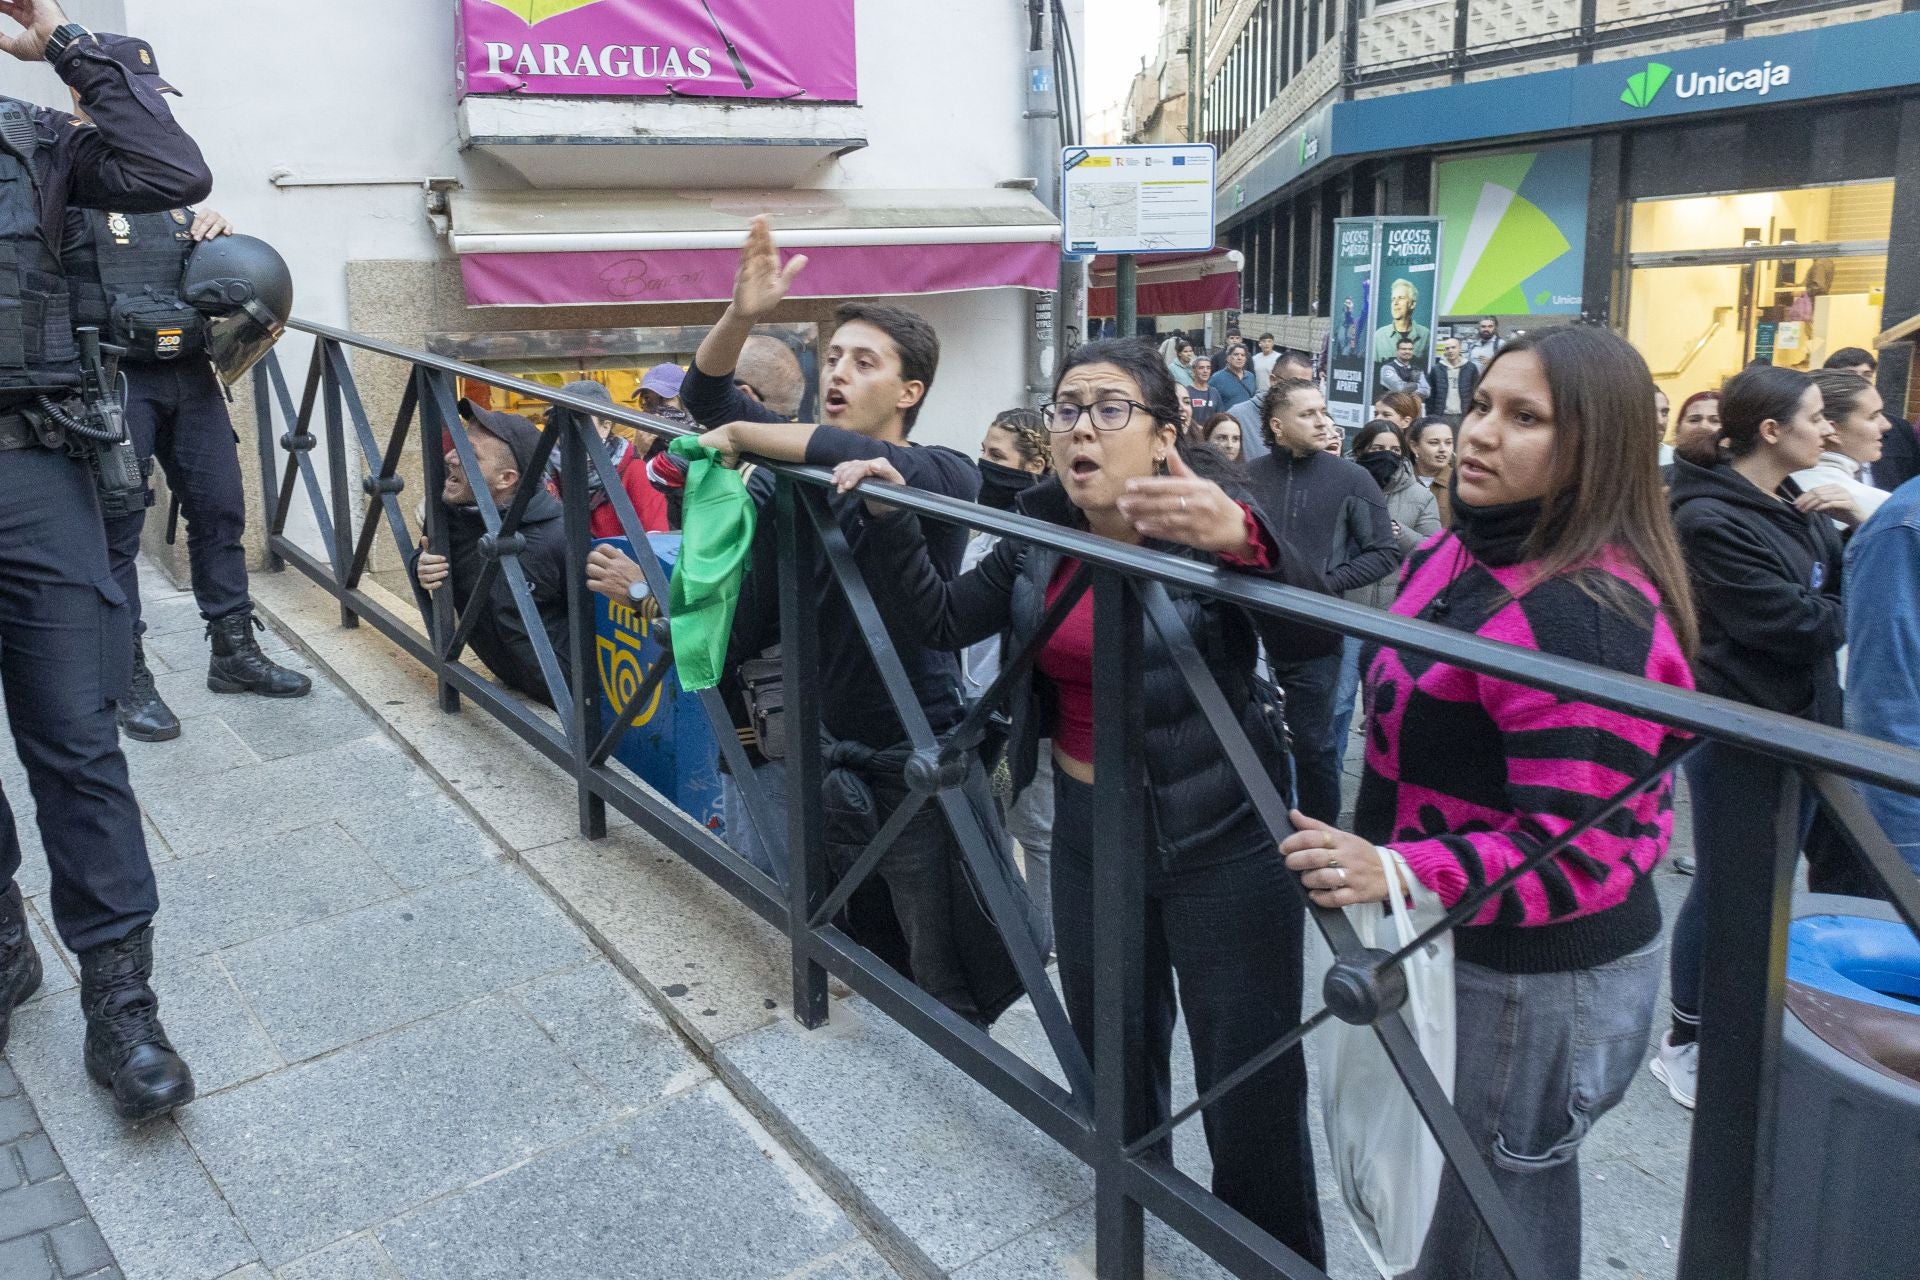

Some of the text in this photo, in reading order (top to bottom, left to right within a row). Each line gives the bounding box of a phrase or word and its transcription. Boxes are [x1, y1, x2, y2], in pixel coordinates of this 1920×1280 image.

[484, 41, 713, 79] PARAGUAS
[1676, 60, 1791, 98] Unicaja
[1388, 229, 1421, 245] LOCOS
